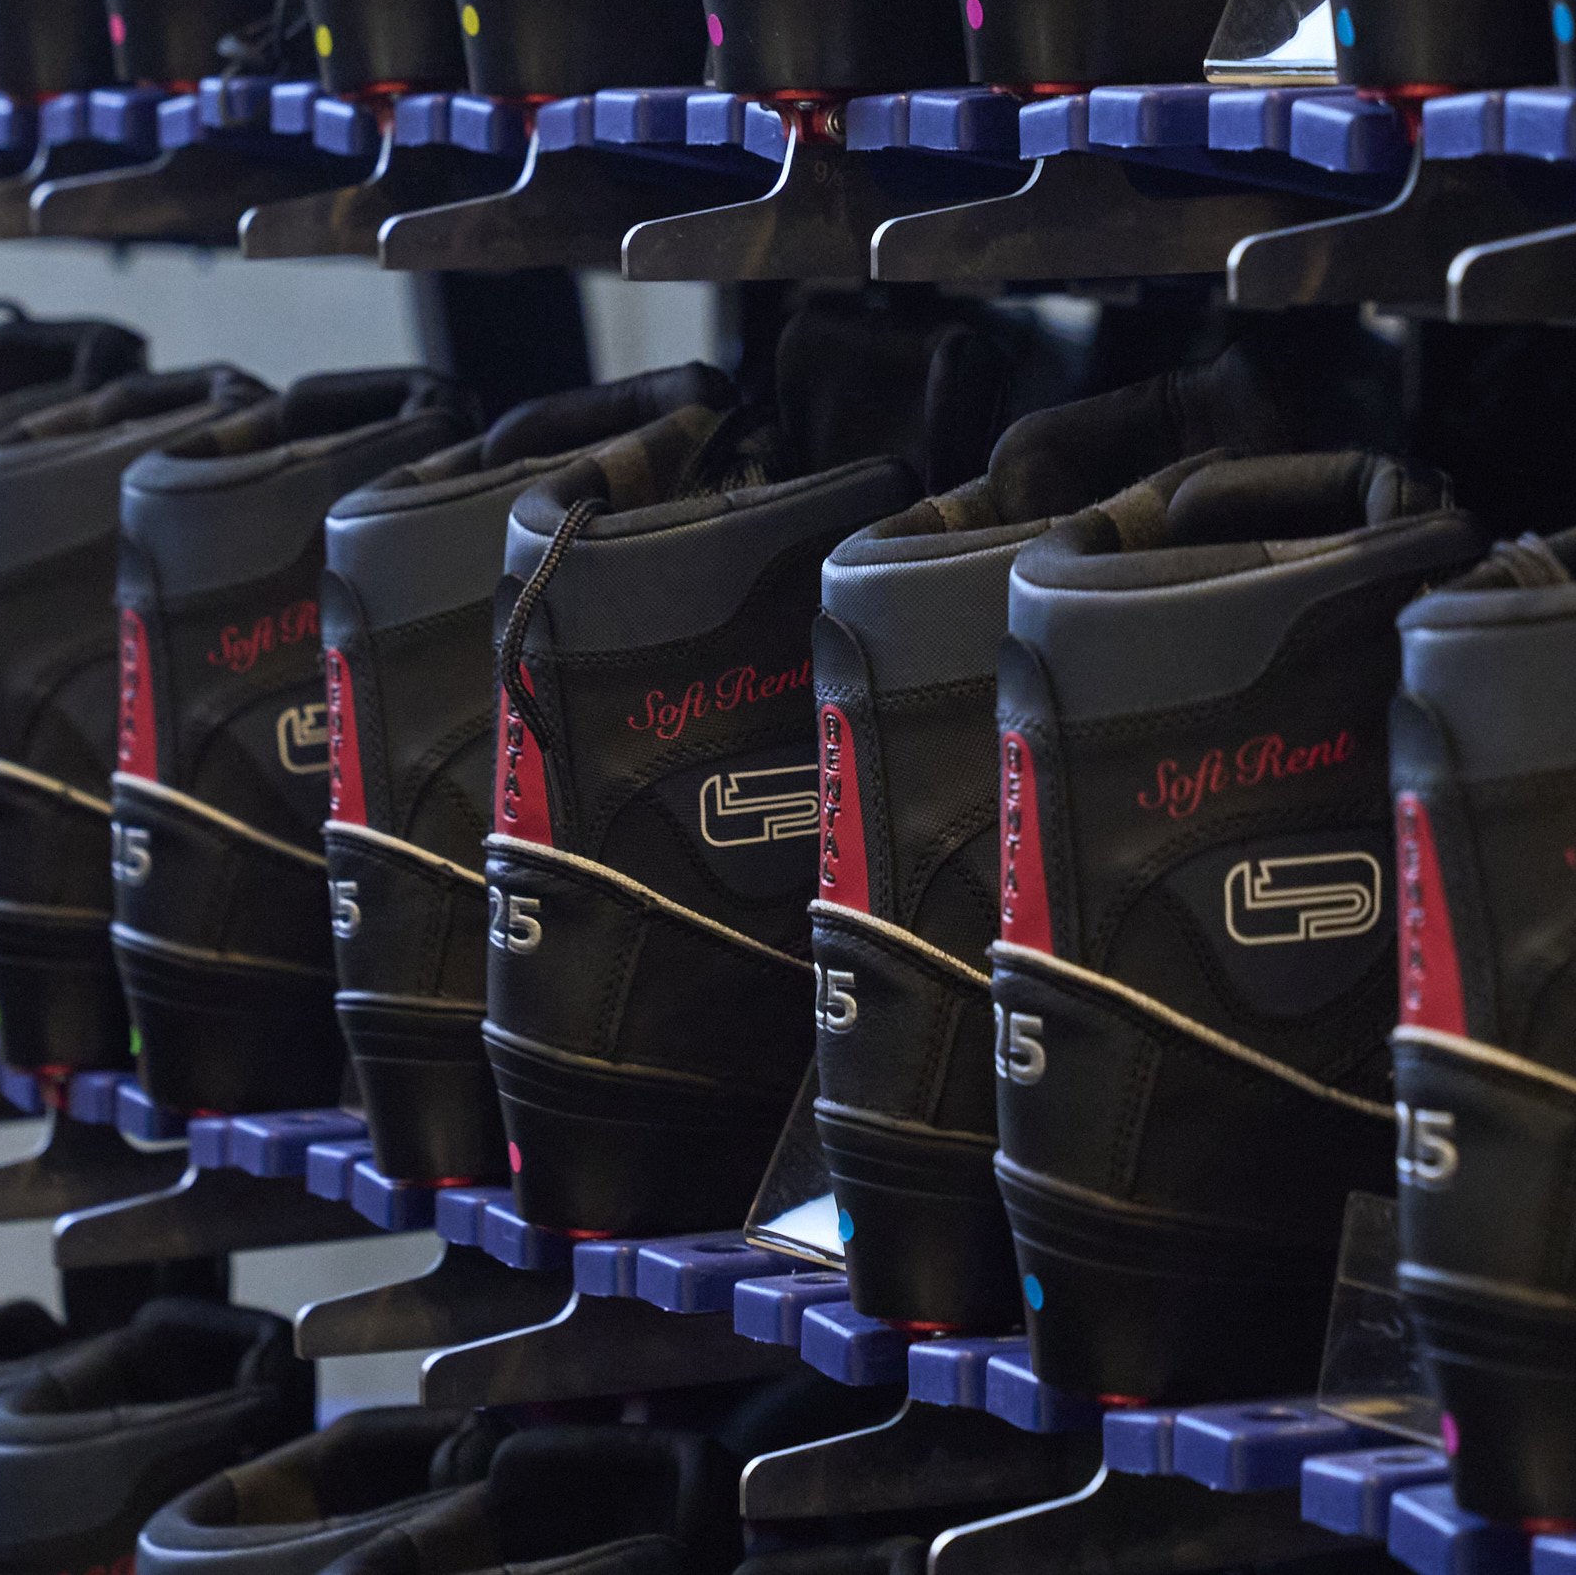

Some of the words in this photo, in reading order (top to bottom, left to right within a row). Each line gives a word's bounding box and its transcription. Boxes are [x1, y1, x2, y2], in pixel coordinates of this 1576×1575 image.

[627, 681, 709, 739] Soft
[823, 712, 843, 888] RENTAL
[1137, 747, 1225, 820] Soft
[1236, 728, 1356, 788] Rent
[488, 886, 543, 954] 25
